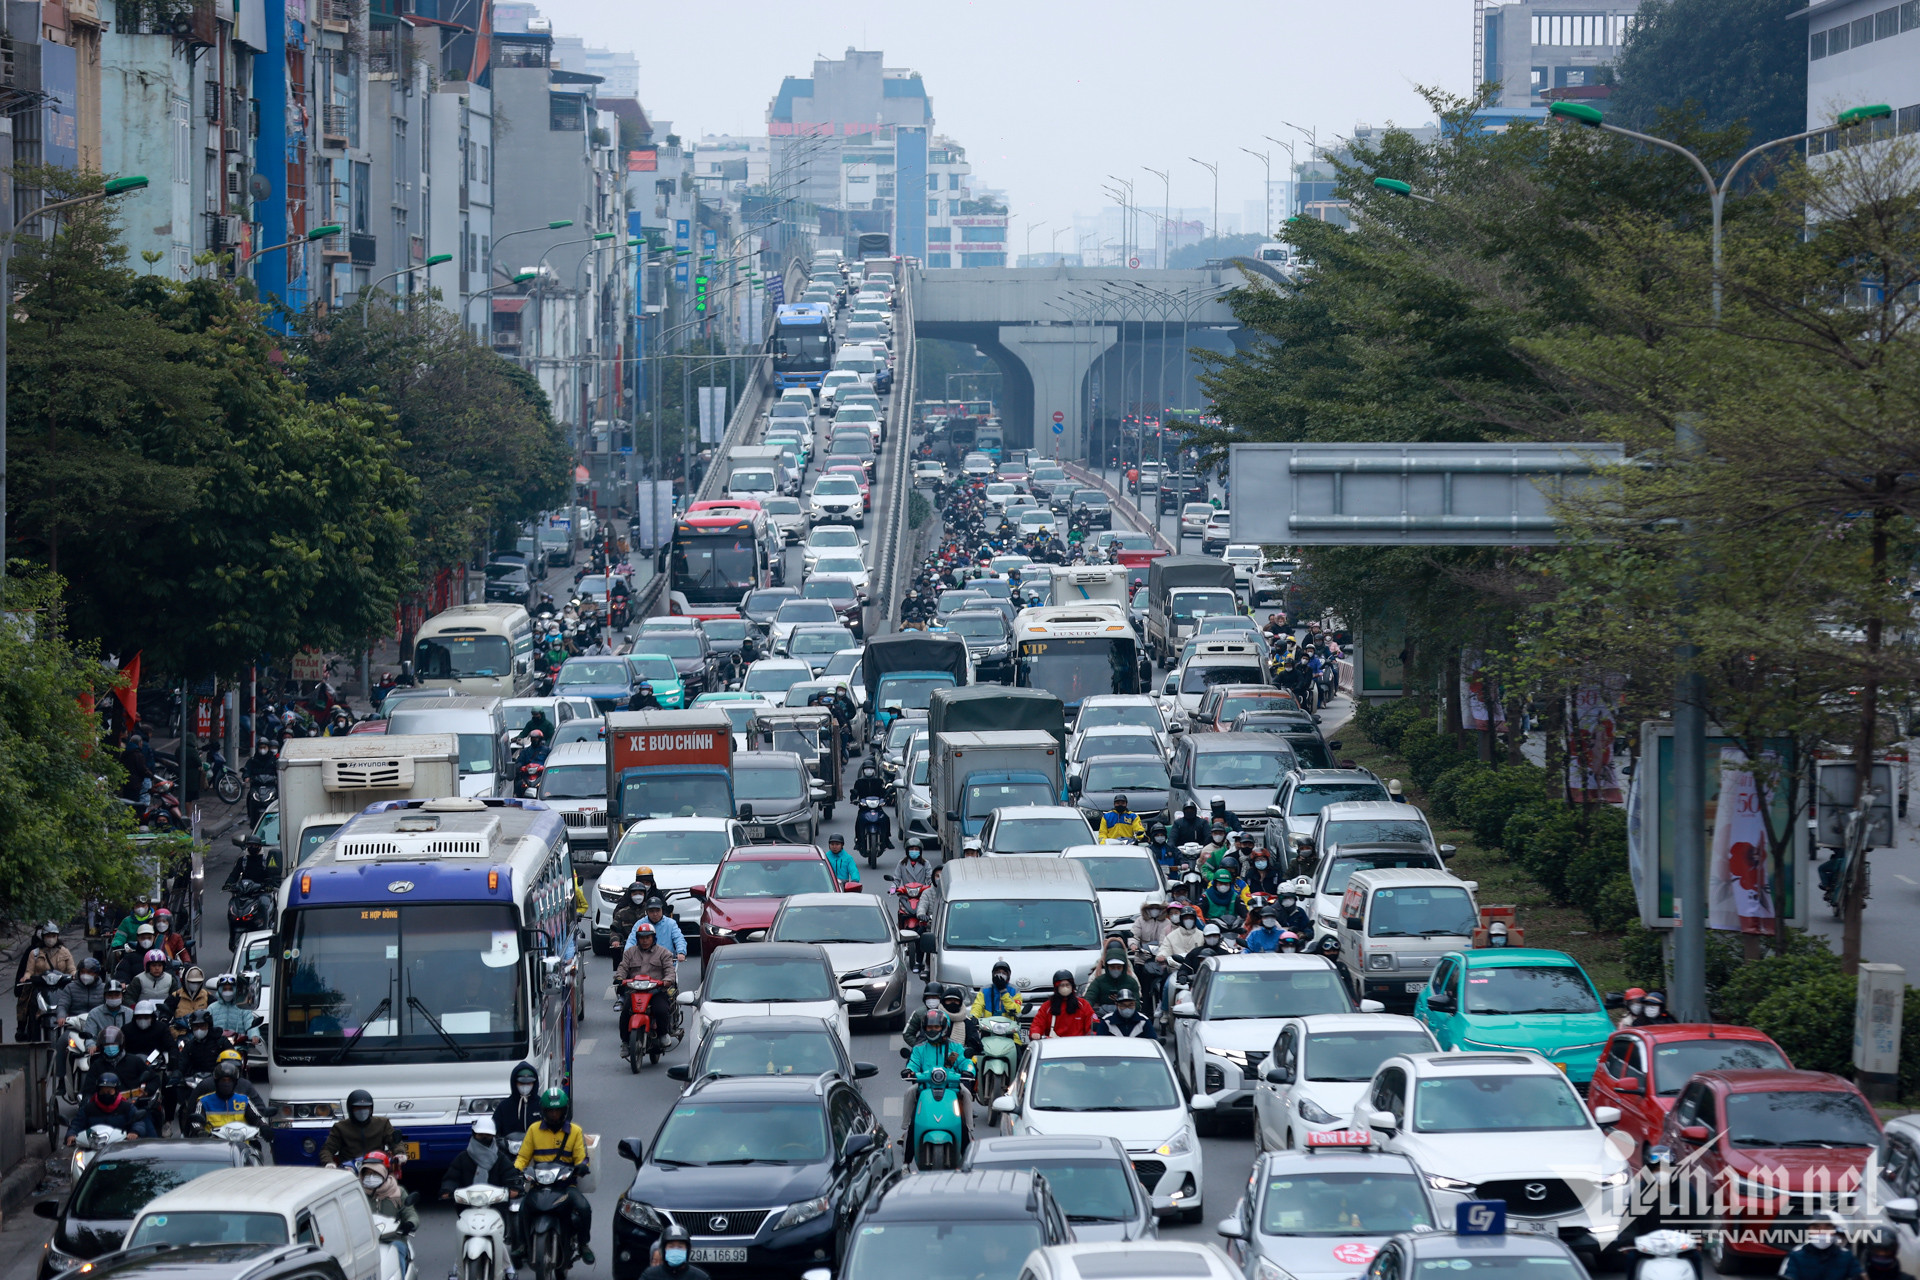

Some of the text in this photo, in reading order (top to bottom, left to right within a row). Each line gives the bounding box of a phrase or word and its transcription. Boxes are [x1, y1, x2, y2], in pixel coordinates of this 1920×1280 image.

[1022, 643, 1048, 655] VIP
[629, 730, 713, 751] XE BƯU CHÍNH
[361, 908, 398, 920] XE HỢP ĐỒNG
[233, 1099, 246, 1111] be
[1340, 1130, 1369, 1144] 123
[1467, 1204, 1496, 1232] G7
[1529, 1223, 1547, 1232] 30K
[689, 1249, 746, 1262] 29A-166.99
